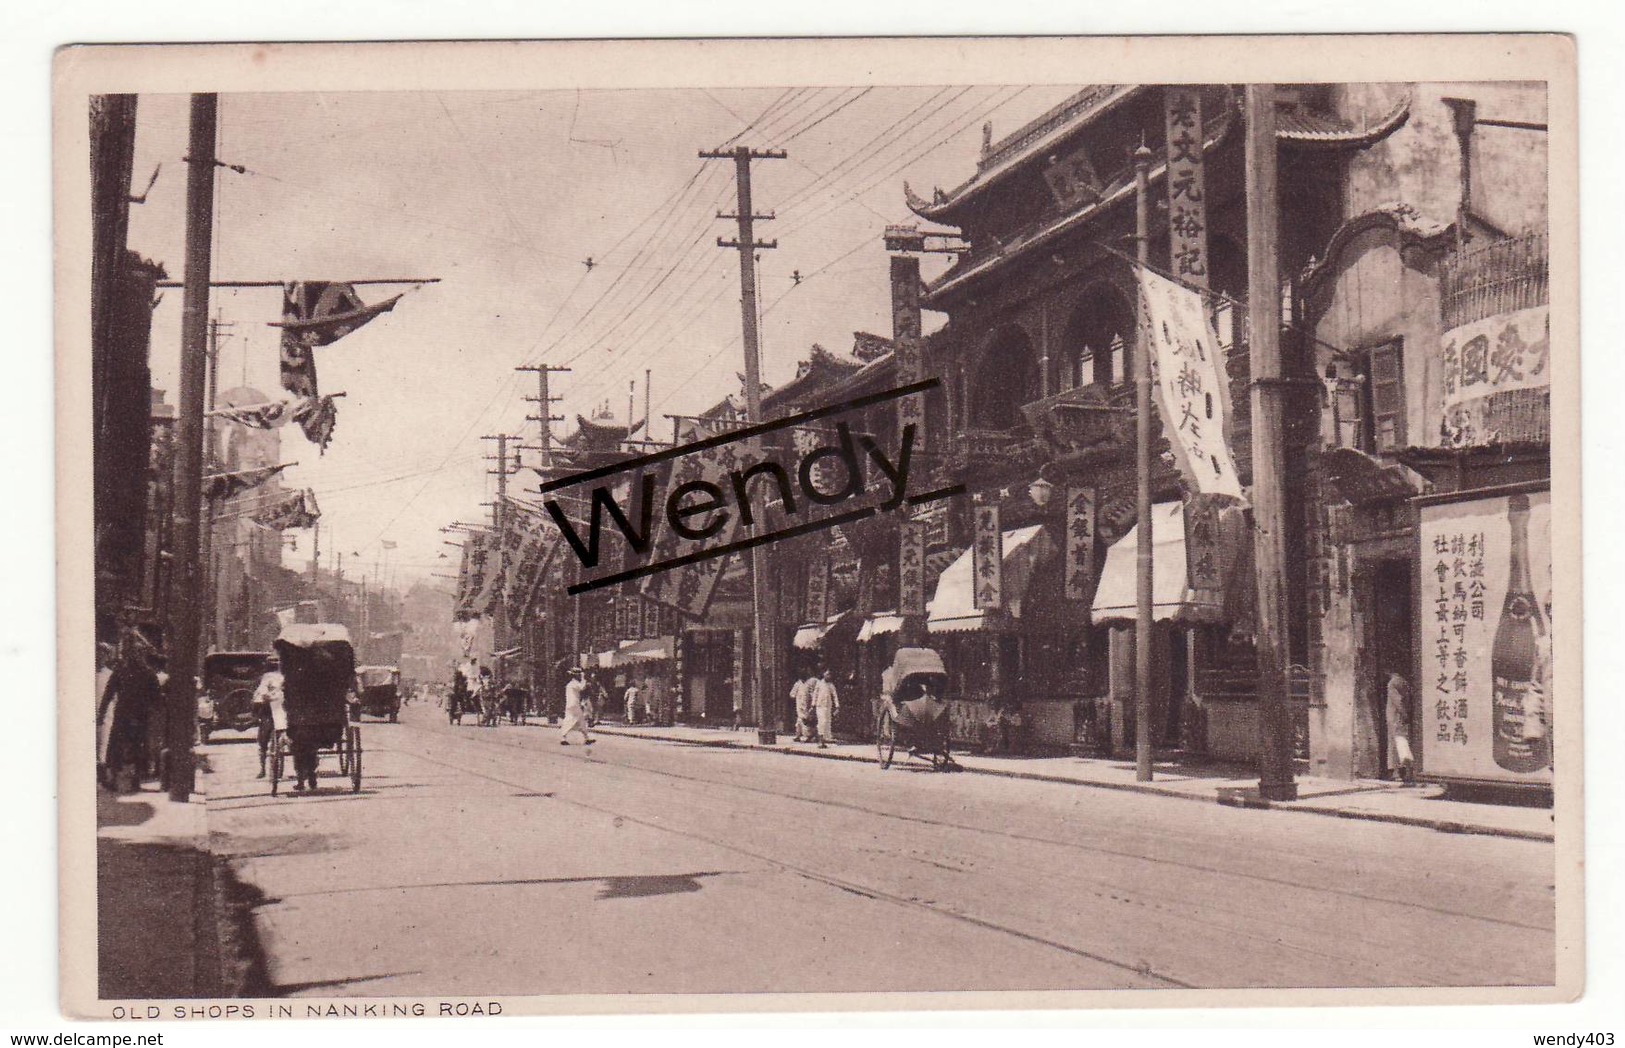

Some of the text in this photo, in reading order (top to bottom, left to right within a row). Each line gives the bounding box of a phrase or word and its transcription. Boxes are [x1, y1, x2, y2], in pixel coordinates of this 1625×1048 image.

[1433, 533, 1450, 742] 社會上最上等之飲品
